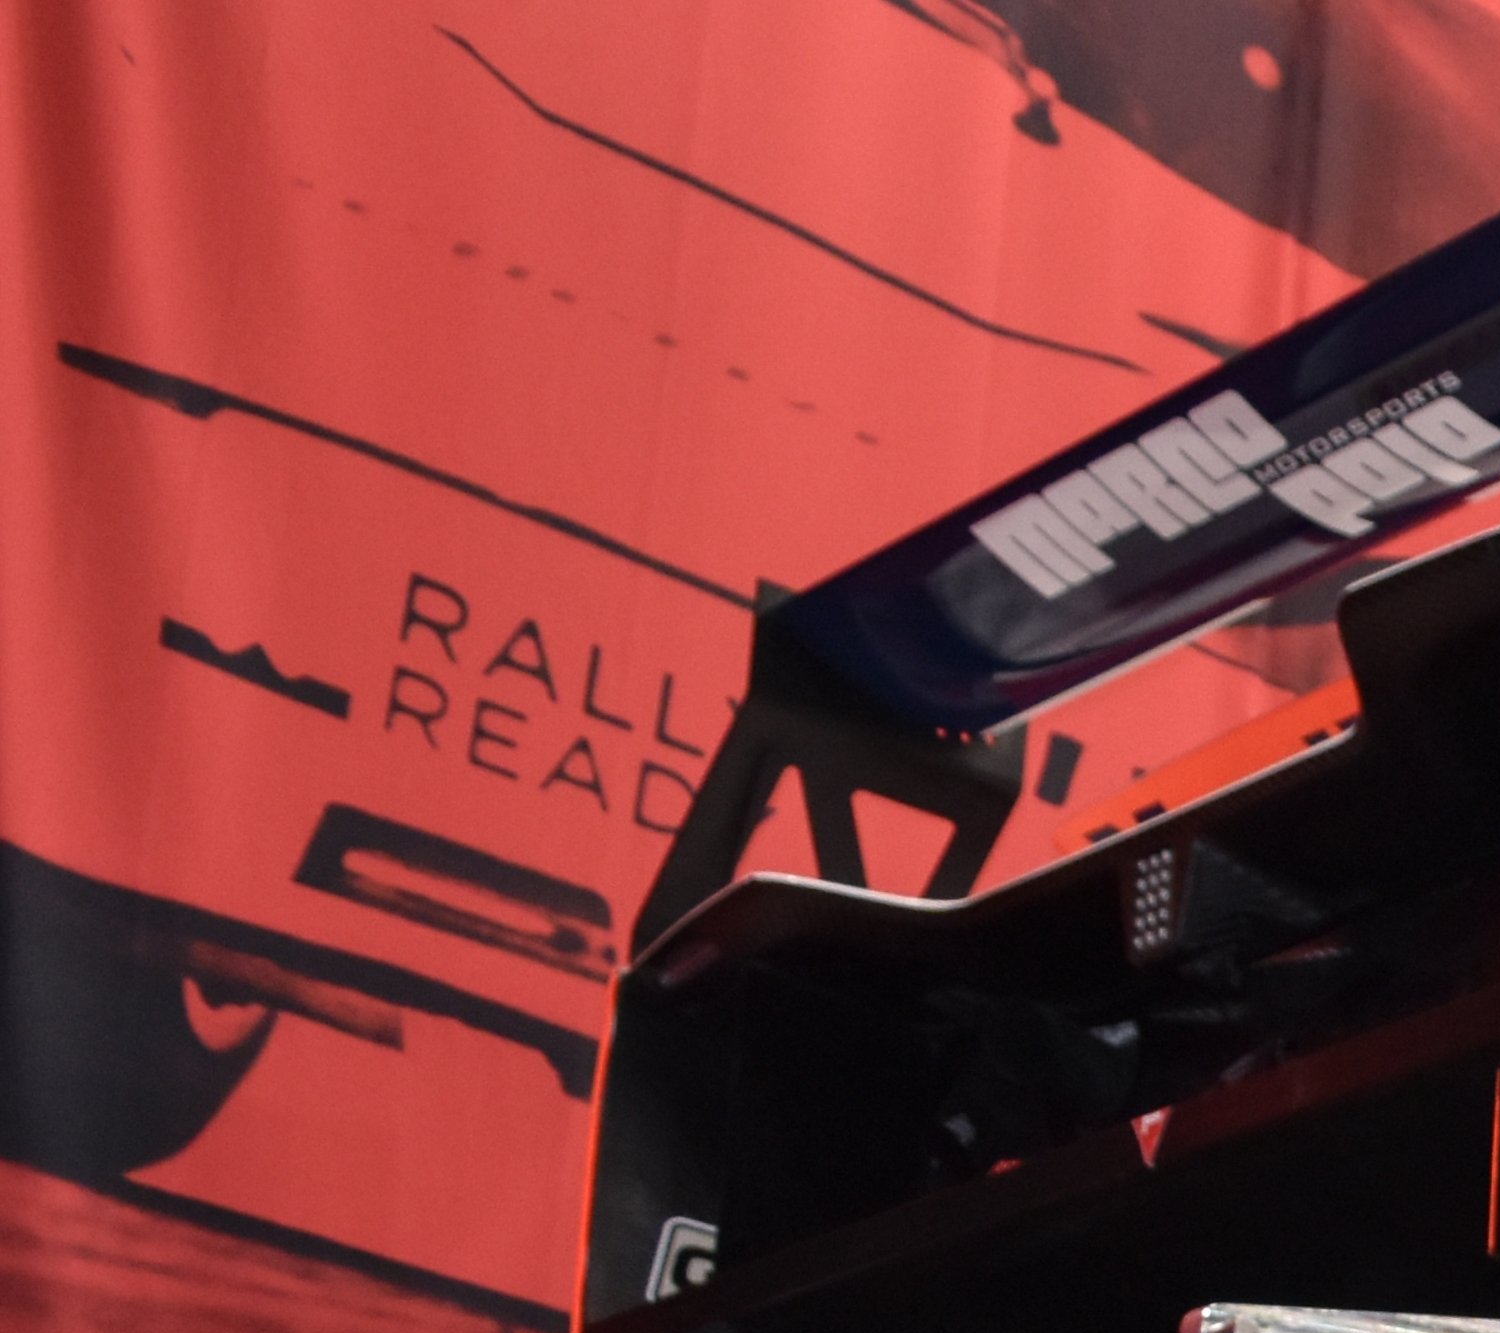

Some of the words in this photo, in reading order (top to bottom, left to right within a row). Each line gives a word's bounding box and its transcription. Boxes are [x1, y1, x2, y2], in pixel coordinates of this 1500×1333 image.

[1254, 370, 1462, 485] MOTORSPORTS
[400, 571, 745, 757] RALL
[385, 665, 703, 834] READ
